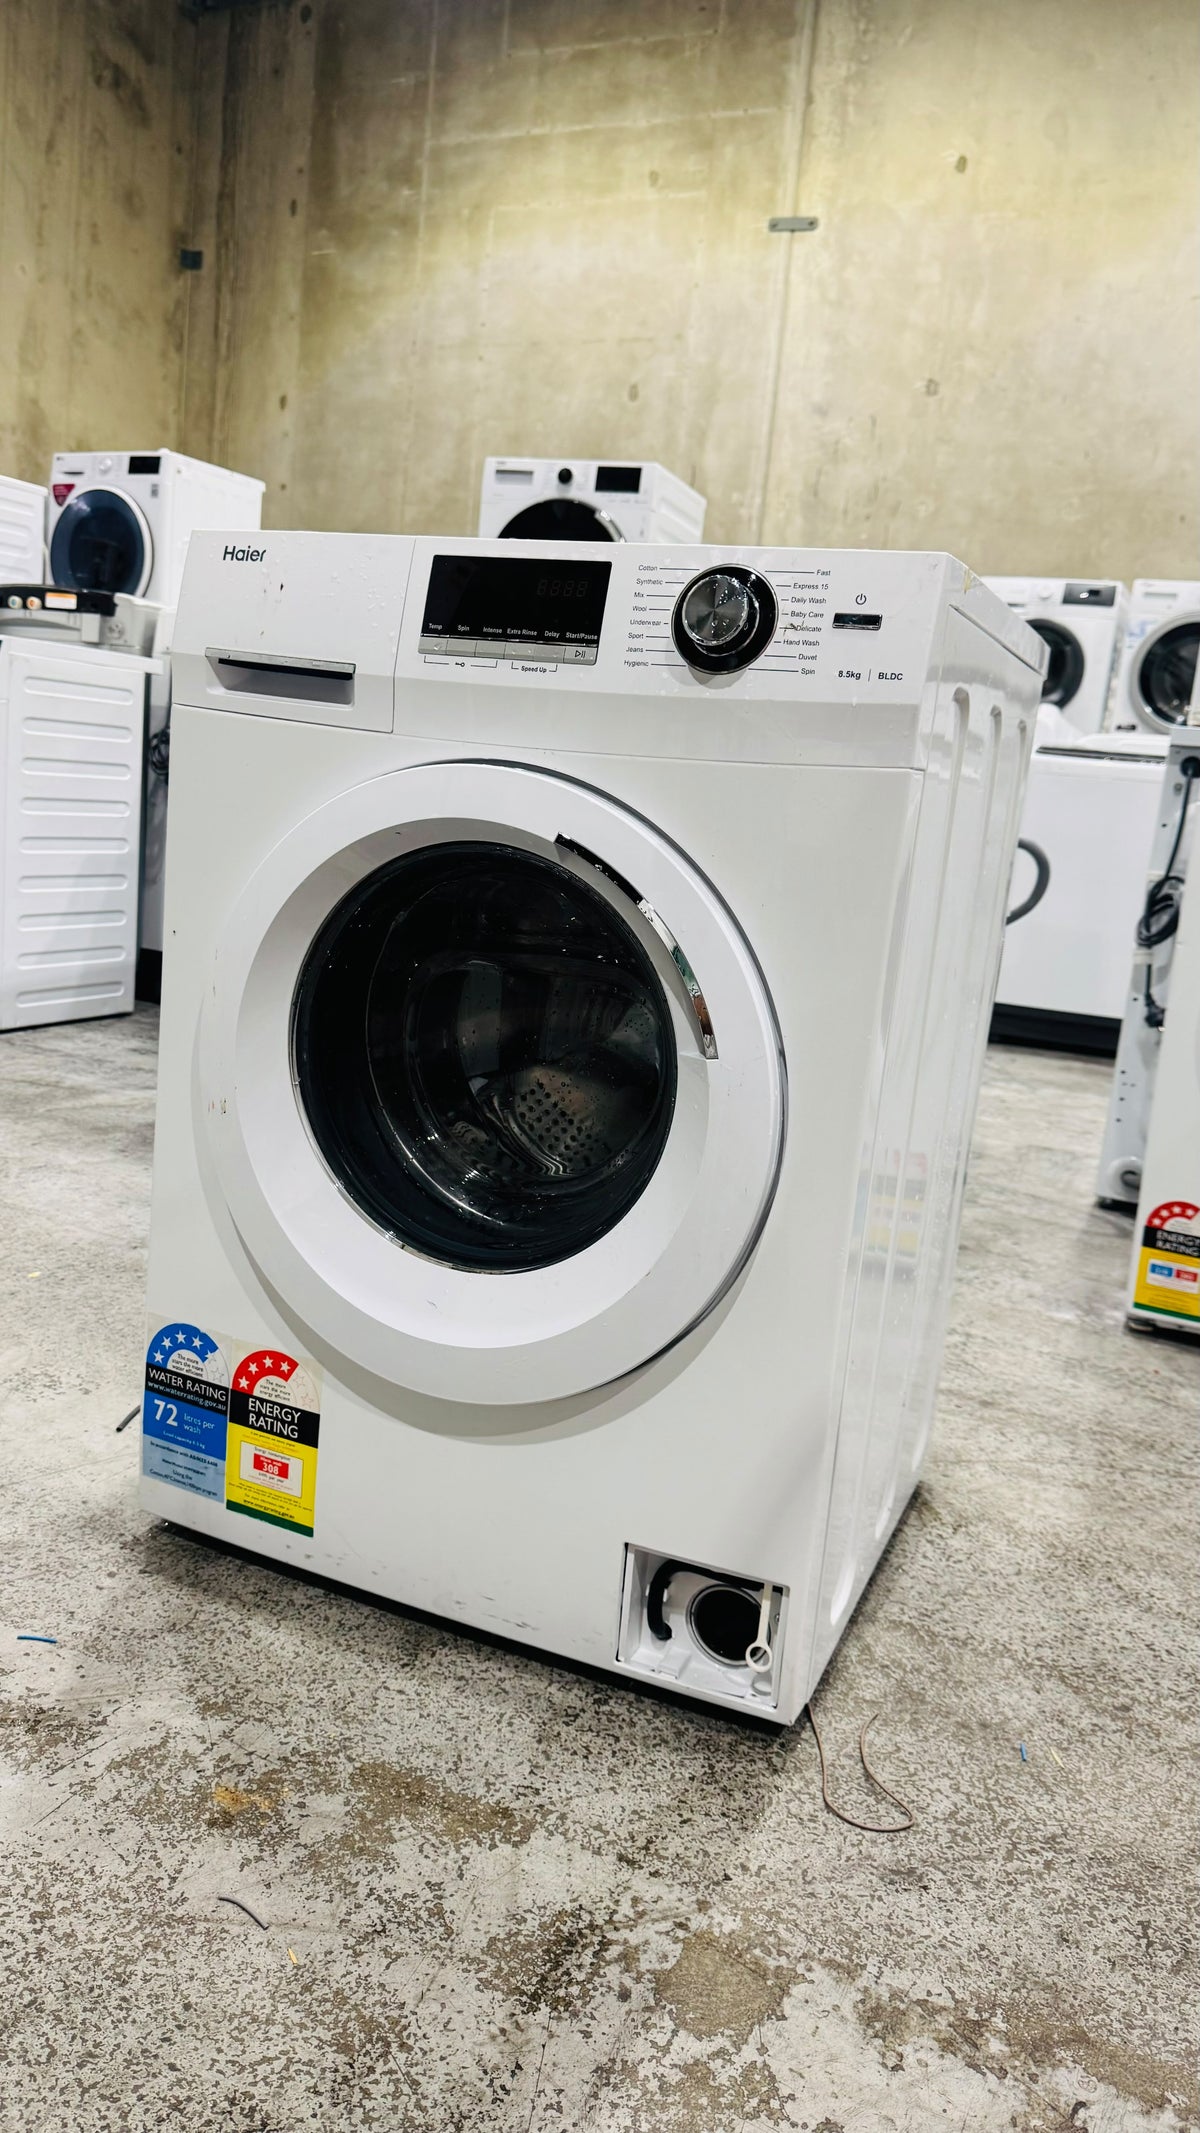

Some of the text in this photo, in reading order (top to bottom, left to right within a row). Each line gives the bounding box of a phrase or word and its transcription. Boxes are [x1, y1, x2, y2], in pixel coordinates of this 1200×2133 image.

[222, 545, 266, 562] Haier
[636, 578, 663, 586] Synthetic
[457, 624, 470, 632] Spin
[483, 626, 503, 634] Intense
[544, 630, 560, 639] Delay
[565, 632, 598, 640] Start/Pause
[624, 659, 649, 667] Hygienic
[521, 665, 547, 674] Speed Up
[838, 670, 903, 681] 8.5kg BLDC
[148, 1368, 227, 1401] WATER RATING
[147, 1381, 227, 1411] www.waterrating.gov.au
[153, 1399, 178, 1427] 72
[248, 1398, 301, 1424] ENERGY
[183, 1424, 201, 1434] wash
[202, 1421, 215, 1430] per
[249, 1413, 298, 1439] RATING
[262, 1462, 279, 1475] 308
